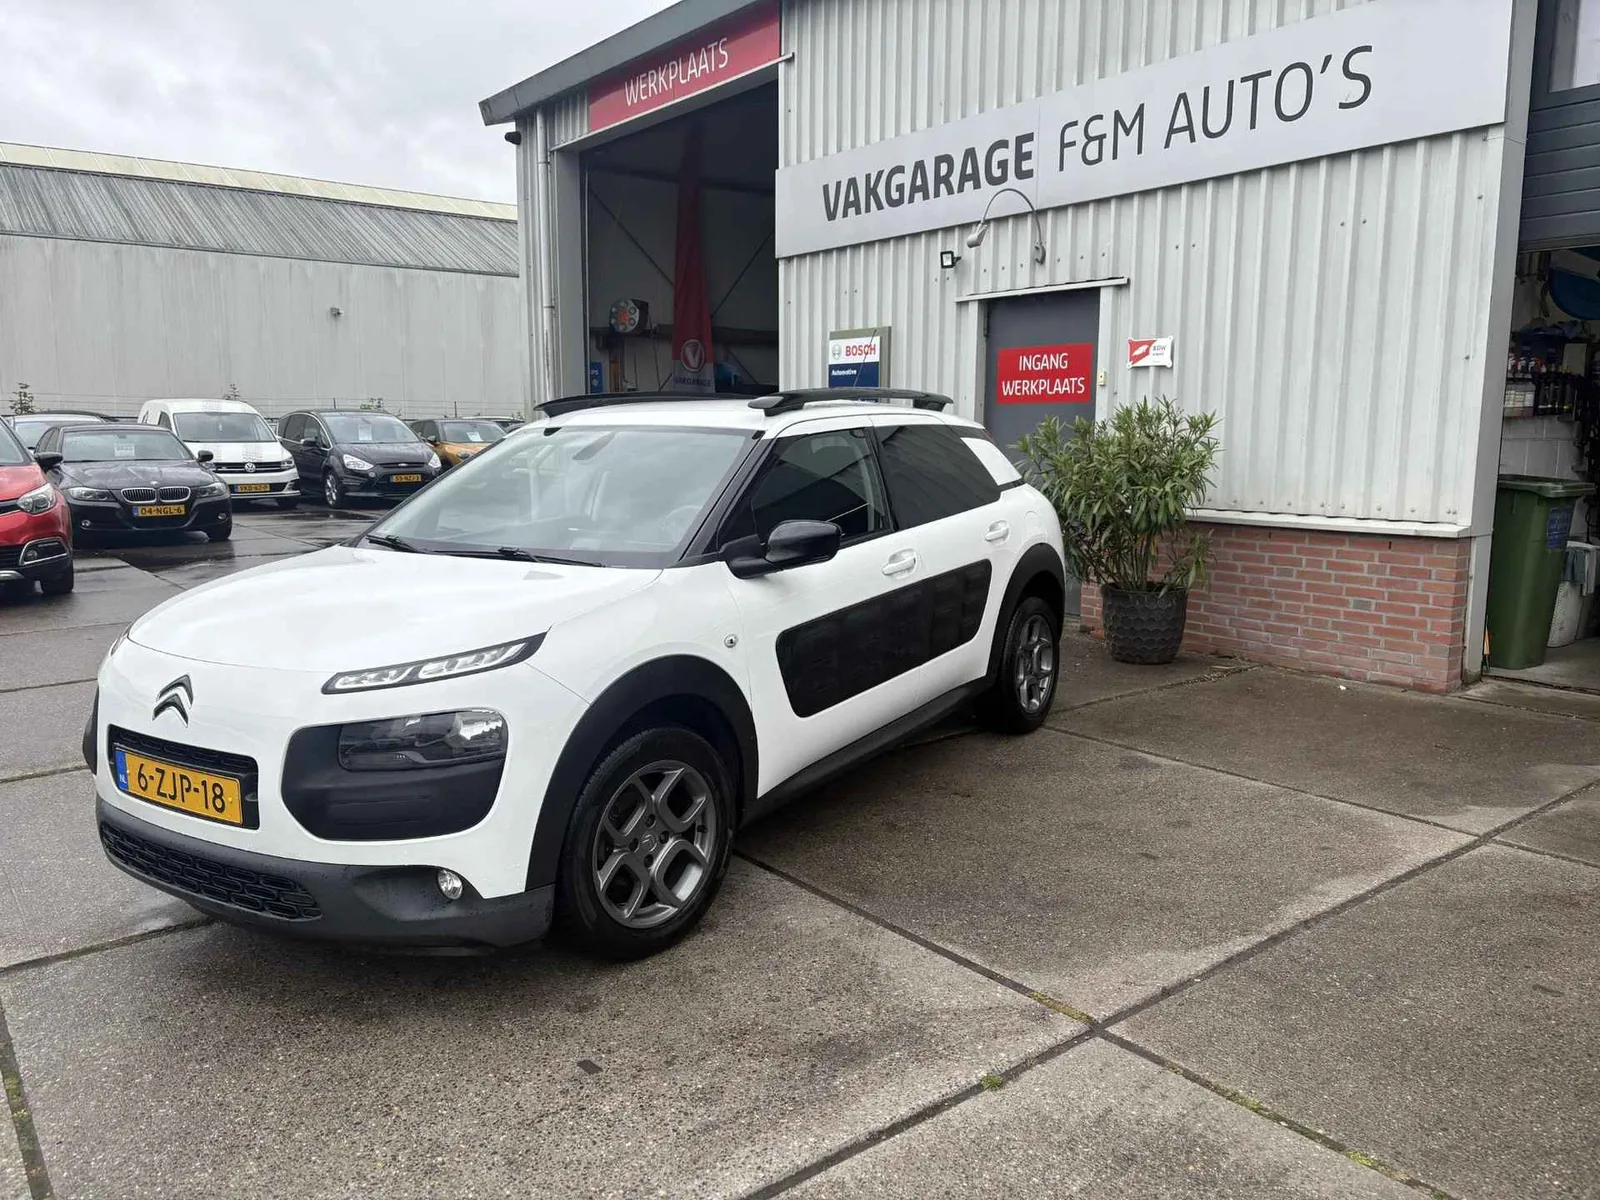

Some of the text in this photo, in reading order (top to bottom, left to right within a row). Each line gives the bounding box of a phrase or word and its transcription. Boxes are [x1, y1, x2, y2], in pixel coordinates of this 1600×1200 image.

[624, 37, 728, 107] WERKPLAATS
[822, 45, 1373, 222] VAKGARAGE F&M AUTO'S
[845, 344, 876, 357] BOSCH
[1019, 352, 1069, 371] INGANG
[831, 368, 857, 376] Automotive
[1002, 377, 1085, 396] WERKPLAATS
[140, 506, 182, 516] 04-NGL-6
[137, 763, 226, 814] 6-ZJP-18
